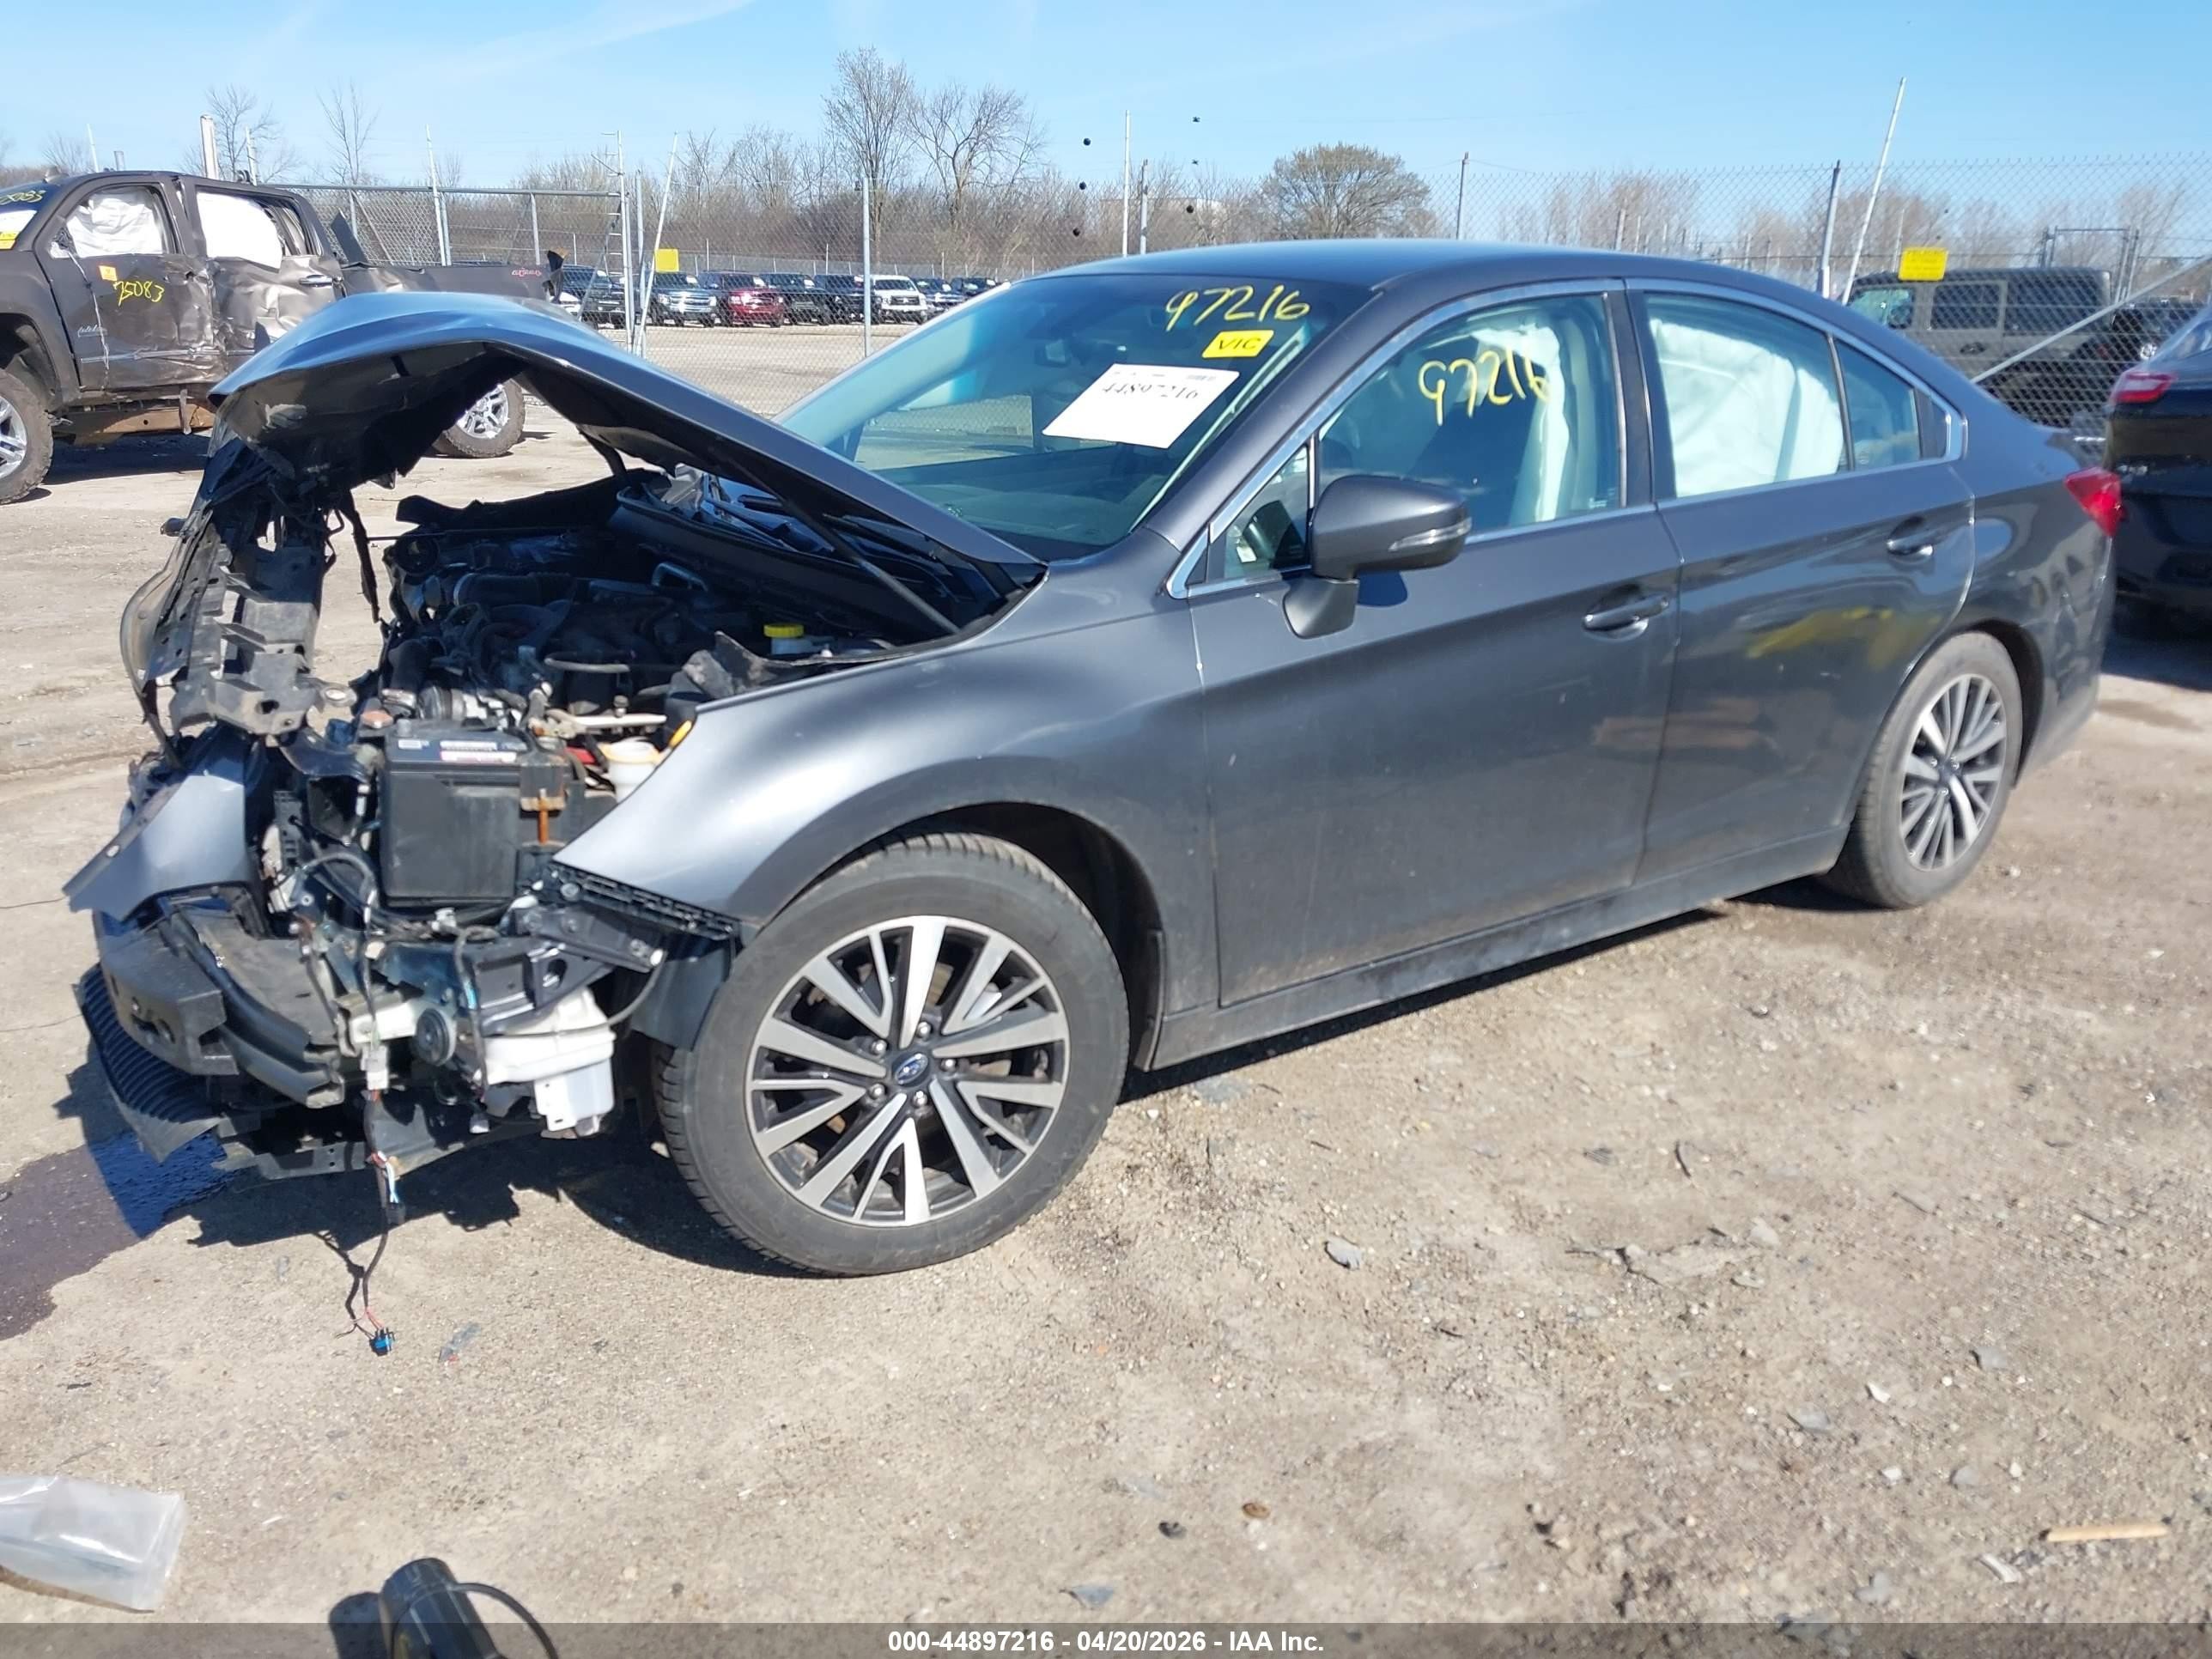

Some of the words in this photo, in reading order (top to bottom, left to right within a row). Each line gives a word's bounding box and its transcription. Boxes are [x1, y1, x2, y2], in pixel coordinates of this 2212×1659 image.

[112, 281, 165, 307] 75083
[1165, 284, 1310, 331] 97216
[1218, 337, 1261, 350] VIC
